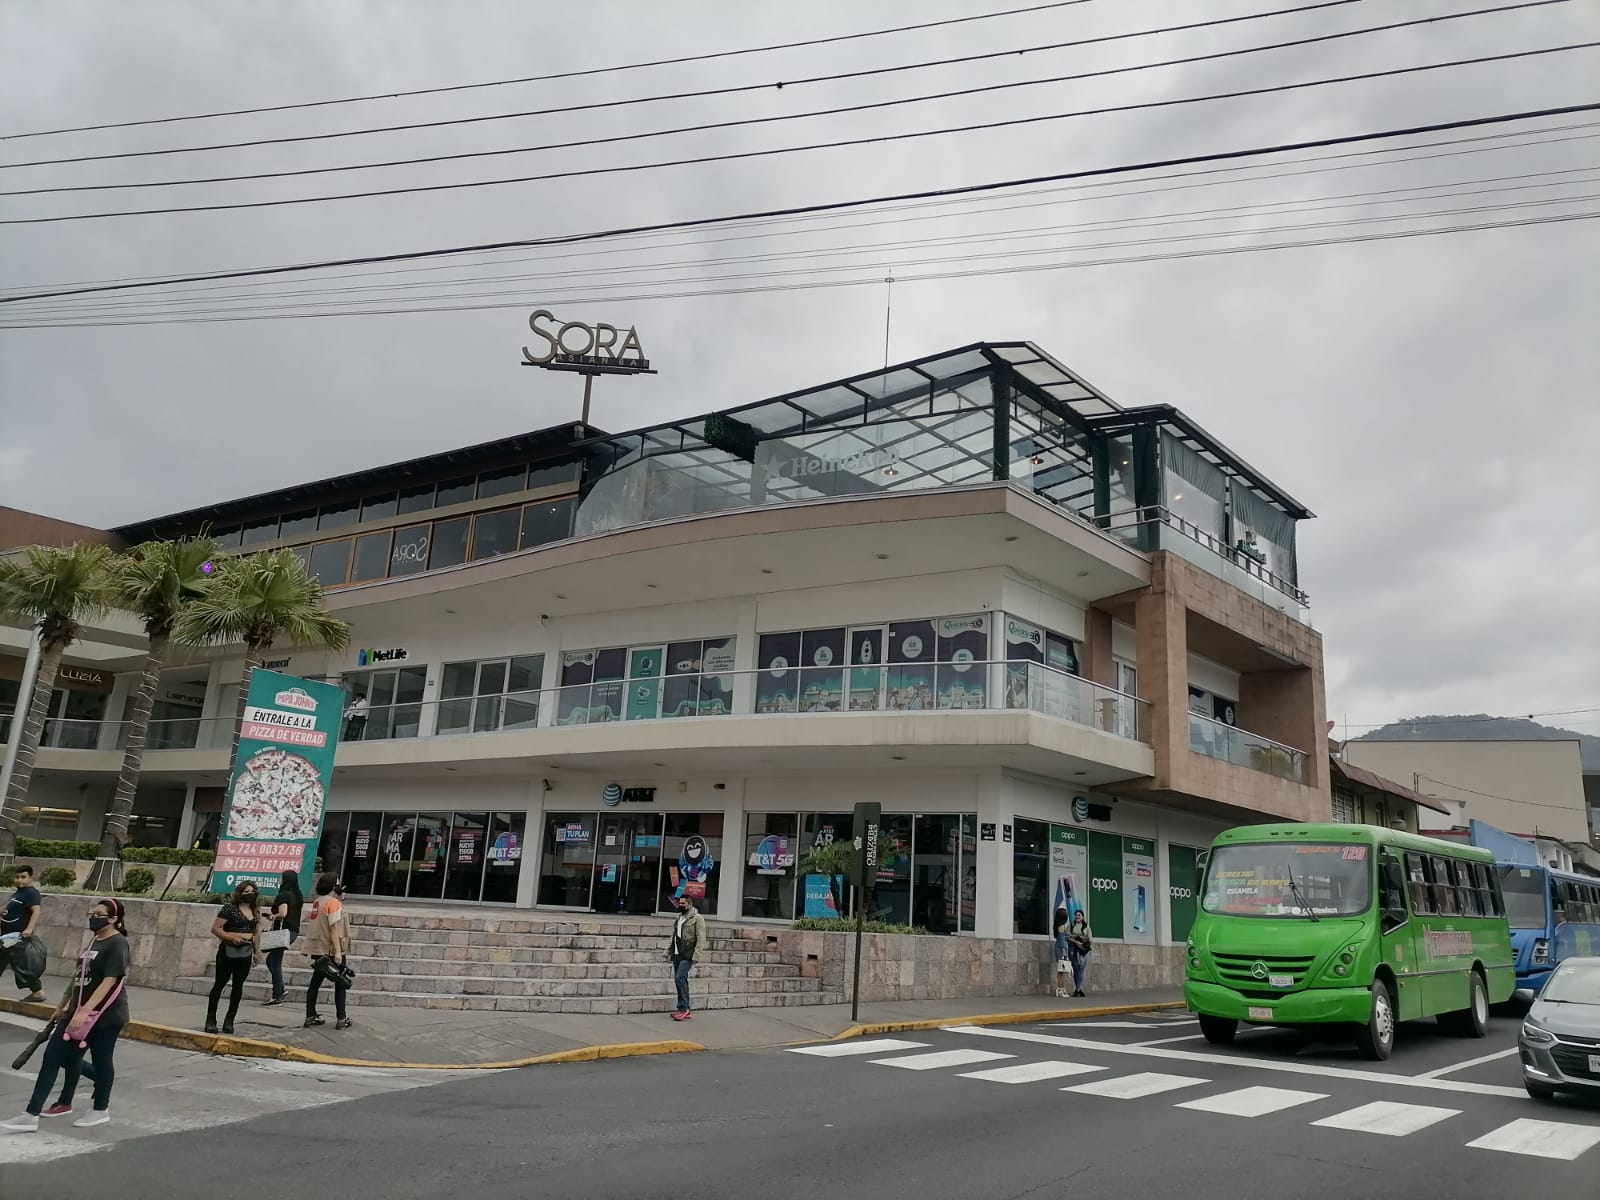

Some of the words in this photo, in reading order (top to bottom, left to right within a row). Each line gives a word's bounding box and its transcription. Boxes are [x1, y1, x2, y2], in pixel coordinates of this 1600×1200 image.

[522, 309, 645, 362] SORA
[556, 354, 609, 365] ASIAN
[618, 359, 649, 369] BAR
[372, 649, 407, 663] MetLife
[253, 709, 293, 726] ÉNTRALE
[293, 716, 300, 728] A
[301, 716, 312, 729] LA
[249, 725, 276, 740] PIZZA
[276, 729, 290, 740] DE
[290, 731, 324, 745] VERDAD
[1061, 831, 1076, 840] oppo
[238, 843, 256, 854] 724
[487, 846, 508, 858] AT&T
[508, 847, 521, 857] 5G
[1131, 843, 1145, 851] oppo
[234, 857, 260, 870] (272)
[262, 860, 278, 869] 167
[389, 852, 401, 863] LO
[748, 852, 776, 866] AT&T
[776, 853, 794, 866] 5G
[1092, 877, 1118, 893] oppo
[1169, 885, 1192, 899] oppo
